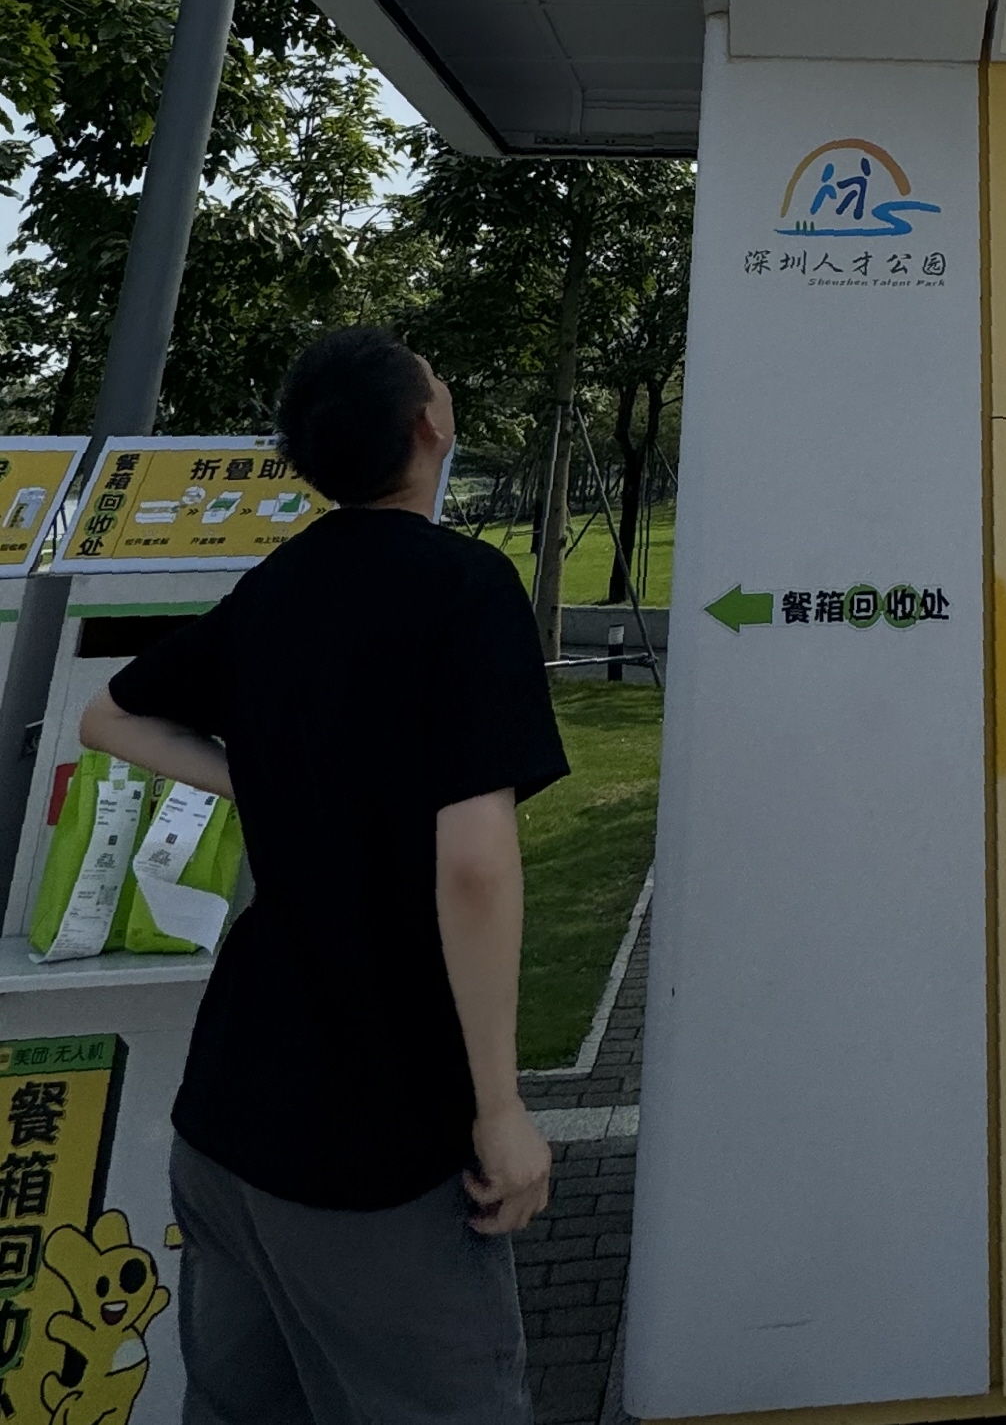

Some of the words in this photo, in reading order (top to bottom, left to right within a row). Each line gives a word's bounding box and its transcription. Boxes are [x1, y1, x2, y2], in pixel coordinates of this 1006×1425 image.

[744, 249, 946, 277] 深圳人才公园
[190, 457, 304, 481] 折叠助
[781, 586, 950, 624] 餐箱回收处
